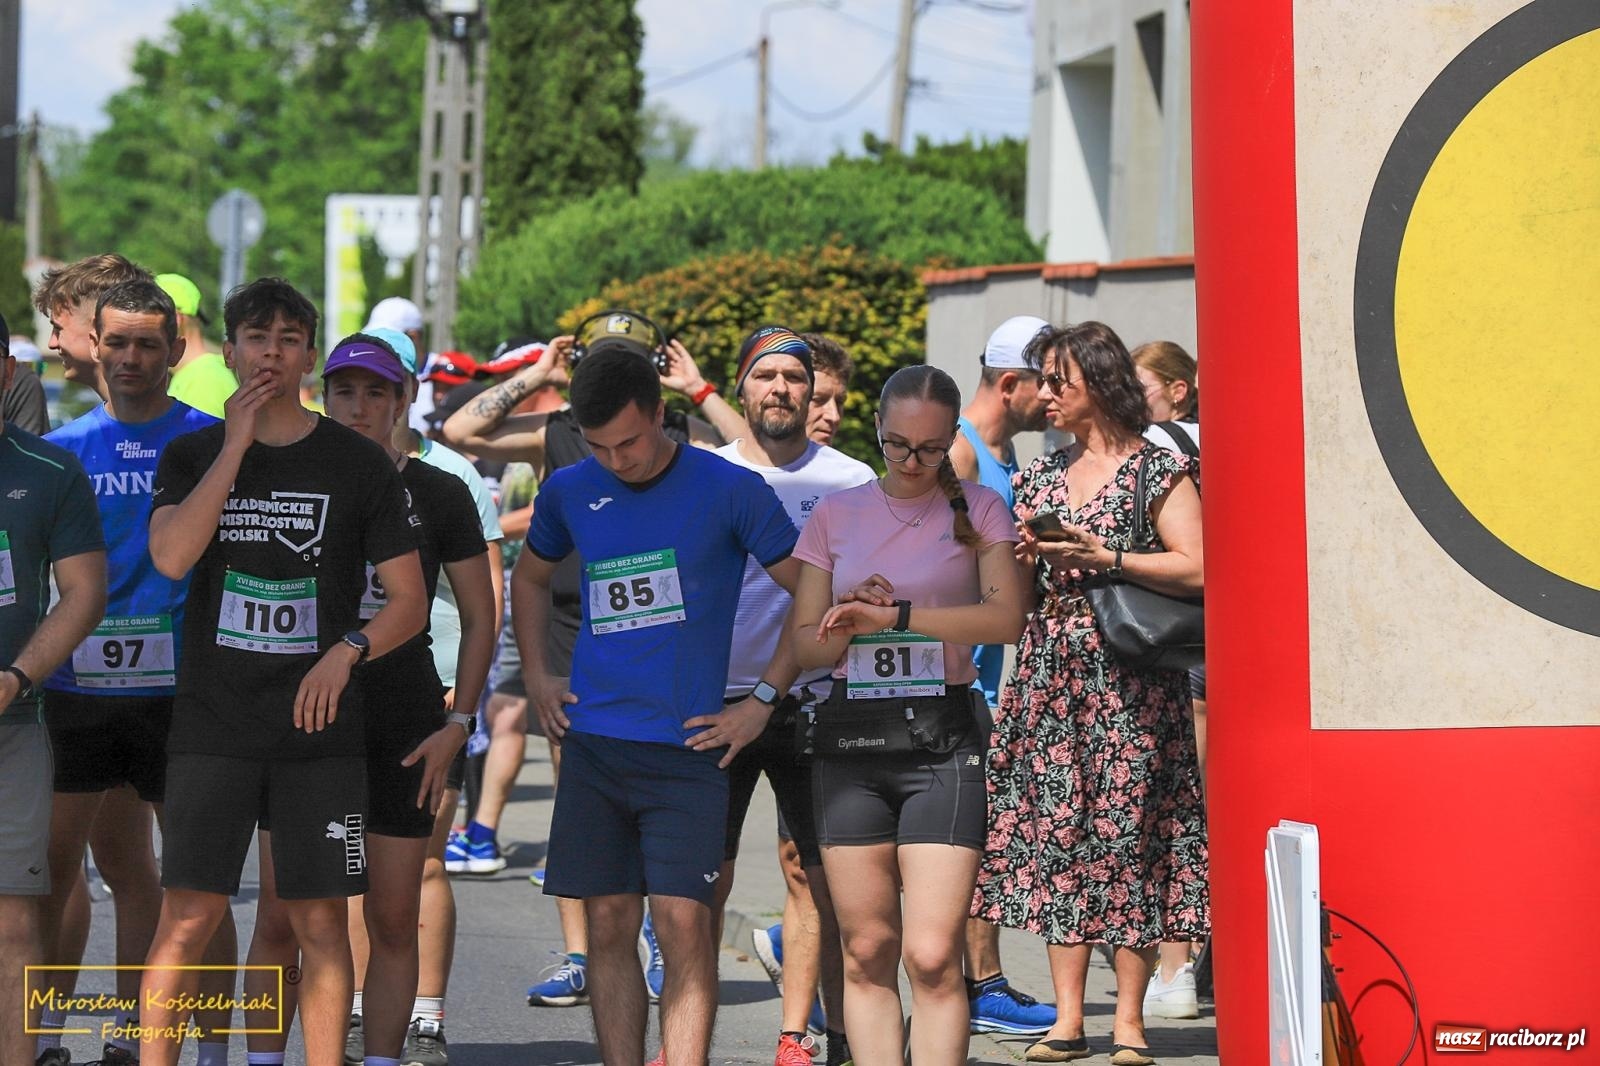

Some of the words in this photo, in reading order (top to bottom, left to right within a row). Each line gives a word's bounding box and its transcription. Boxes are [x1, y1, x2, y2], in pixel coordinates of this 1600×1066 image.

[6, 489, 28, 500] 4F
[223, 498, 314, 515] AKADEMICKIE
[219, 513, 315, 531] MISTRZOSTWA
[219, 529, 269, 542] POLSKI
[617, 558, 632, 567] BEZ
[632, 553, 663, 564] GRANIC
[236, 576, 248, 585] XVI
[248, 580, 264, 589] BIEG
[265, 583, 279, 591] BEZ
[280, 582, 306, 591] GRANIC
[608, 576, 655, 612] 85
[130, 617, 160, 626] GRANIC
[243, 600, 297, 634] 110
[102, 639, 145, 668] 97
[874, 646, 912, 678] 81
[838, 738, 885, 749] GymBeam
[345, 814, 363, 875] PUMA
